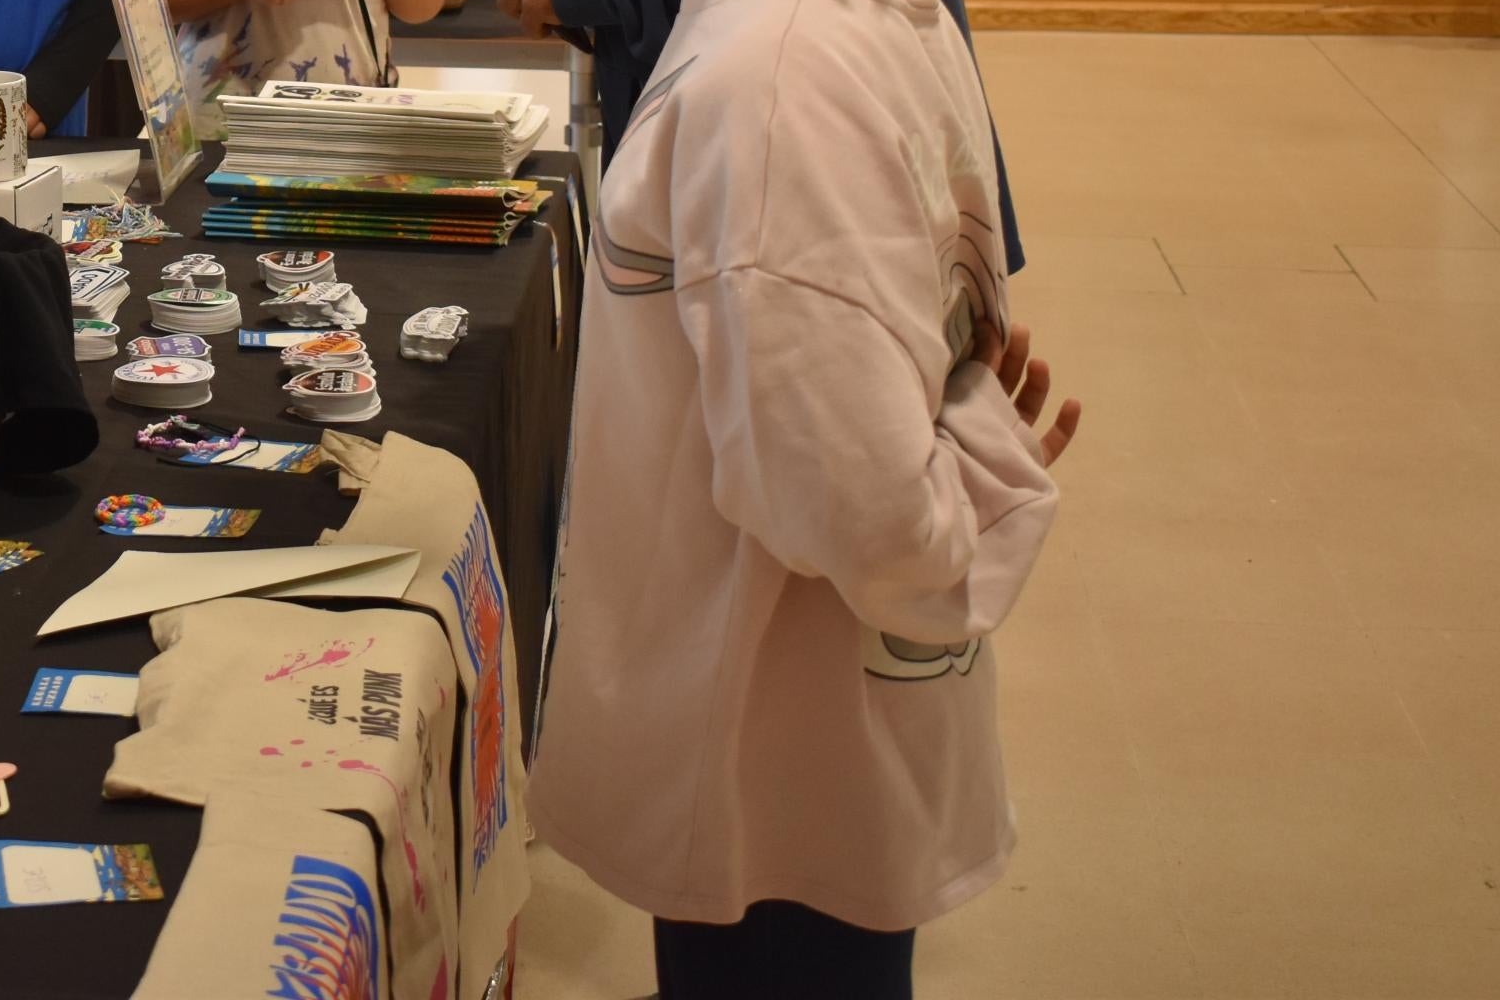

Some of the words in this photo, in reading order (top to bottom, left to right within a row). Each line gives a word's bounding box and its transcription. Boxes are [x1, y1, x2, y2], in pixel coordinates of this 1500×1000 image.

[311, 685, 340, 697] ES
[362, 668, 403, 707] PUNK
[297, 697, 339, 725] ¿QUÉ
[343, 705, 401, 742] MÁS
